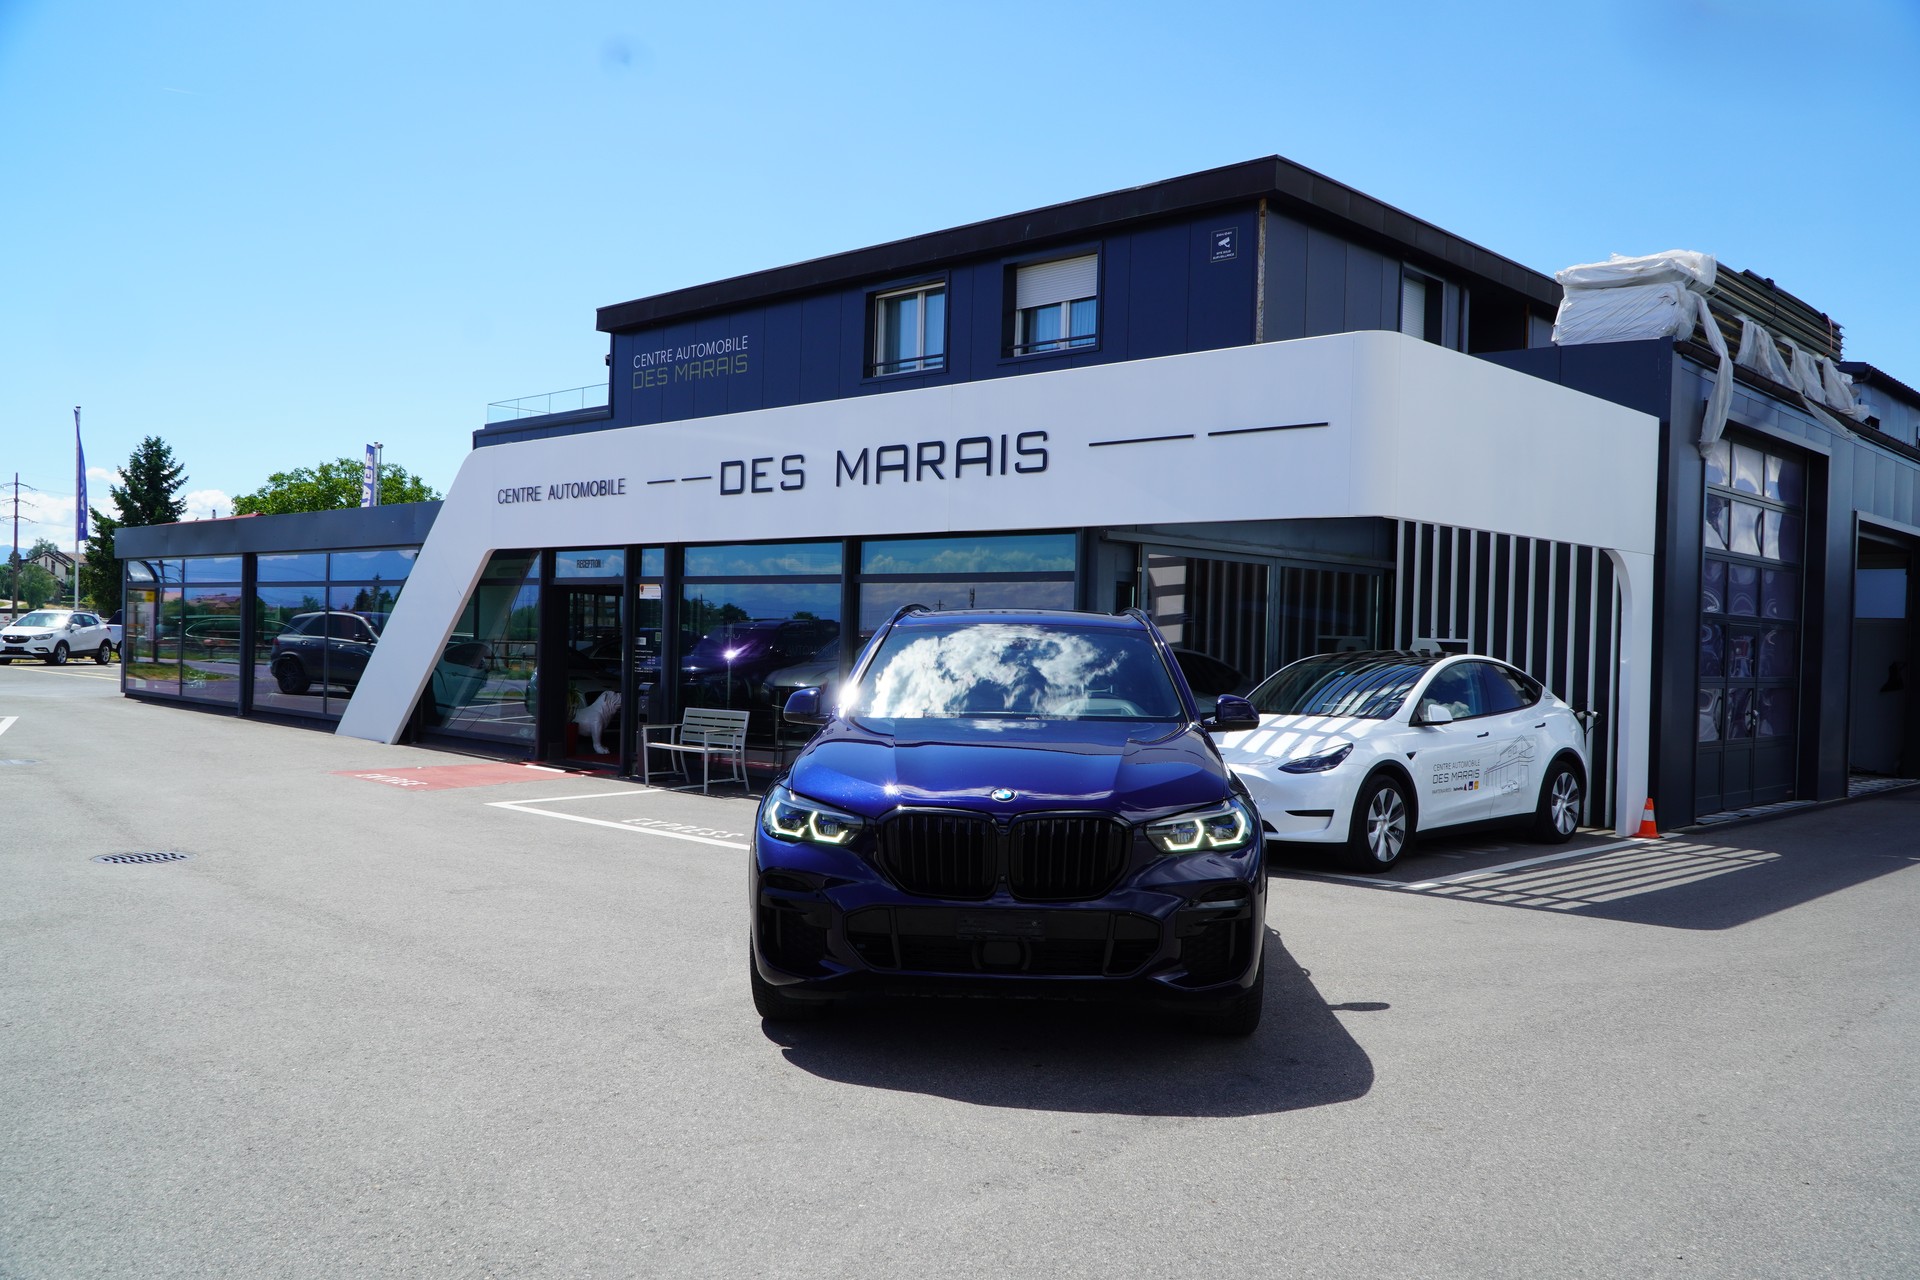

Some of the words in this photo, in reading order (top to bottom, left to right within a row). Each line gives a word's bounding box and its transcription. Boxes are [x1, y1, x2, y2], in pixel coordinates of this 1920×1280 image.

[633, 350, 673, 369] CENTRE
[675, 335, 749, 361] AUTOMOBILE
[633, 367, 668, 390] DES
[674, 354, 748, 383] MARAIS
[719, 454, 805, 496] DES
[835, 430, 1049, 488] MARAIS
[497, 485, 542, 505] CENTRE
[547, 478, 626, 501] AUTOMOBILE
[1432, 772, 1450, 785] DES
[1450, 768, 1480, 781] MARAIS
[1433, 762, 1452, 772] CENTRE
[1452, 758, 1480, 769] AUTOMOBILE
[621, 817, 744, 839] EXPRESS
